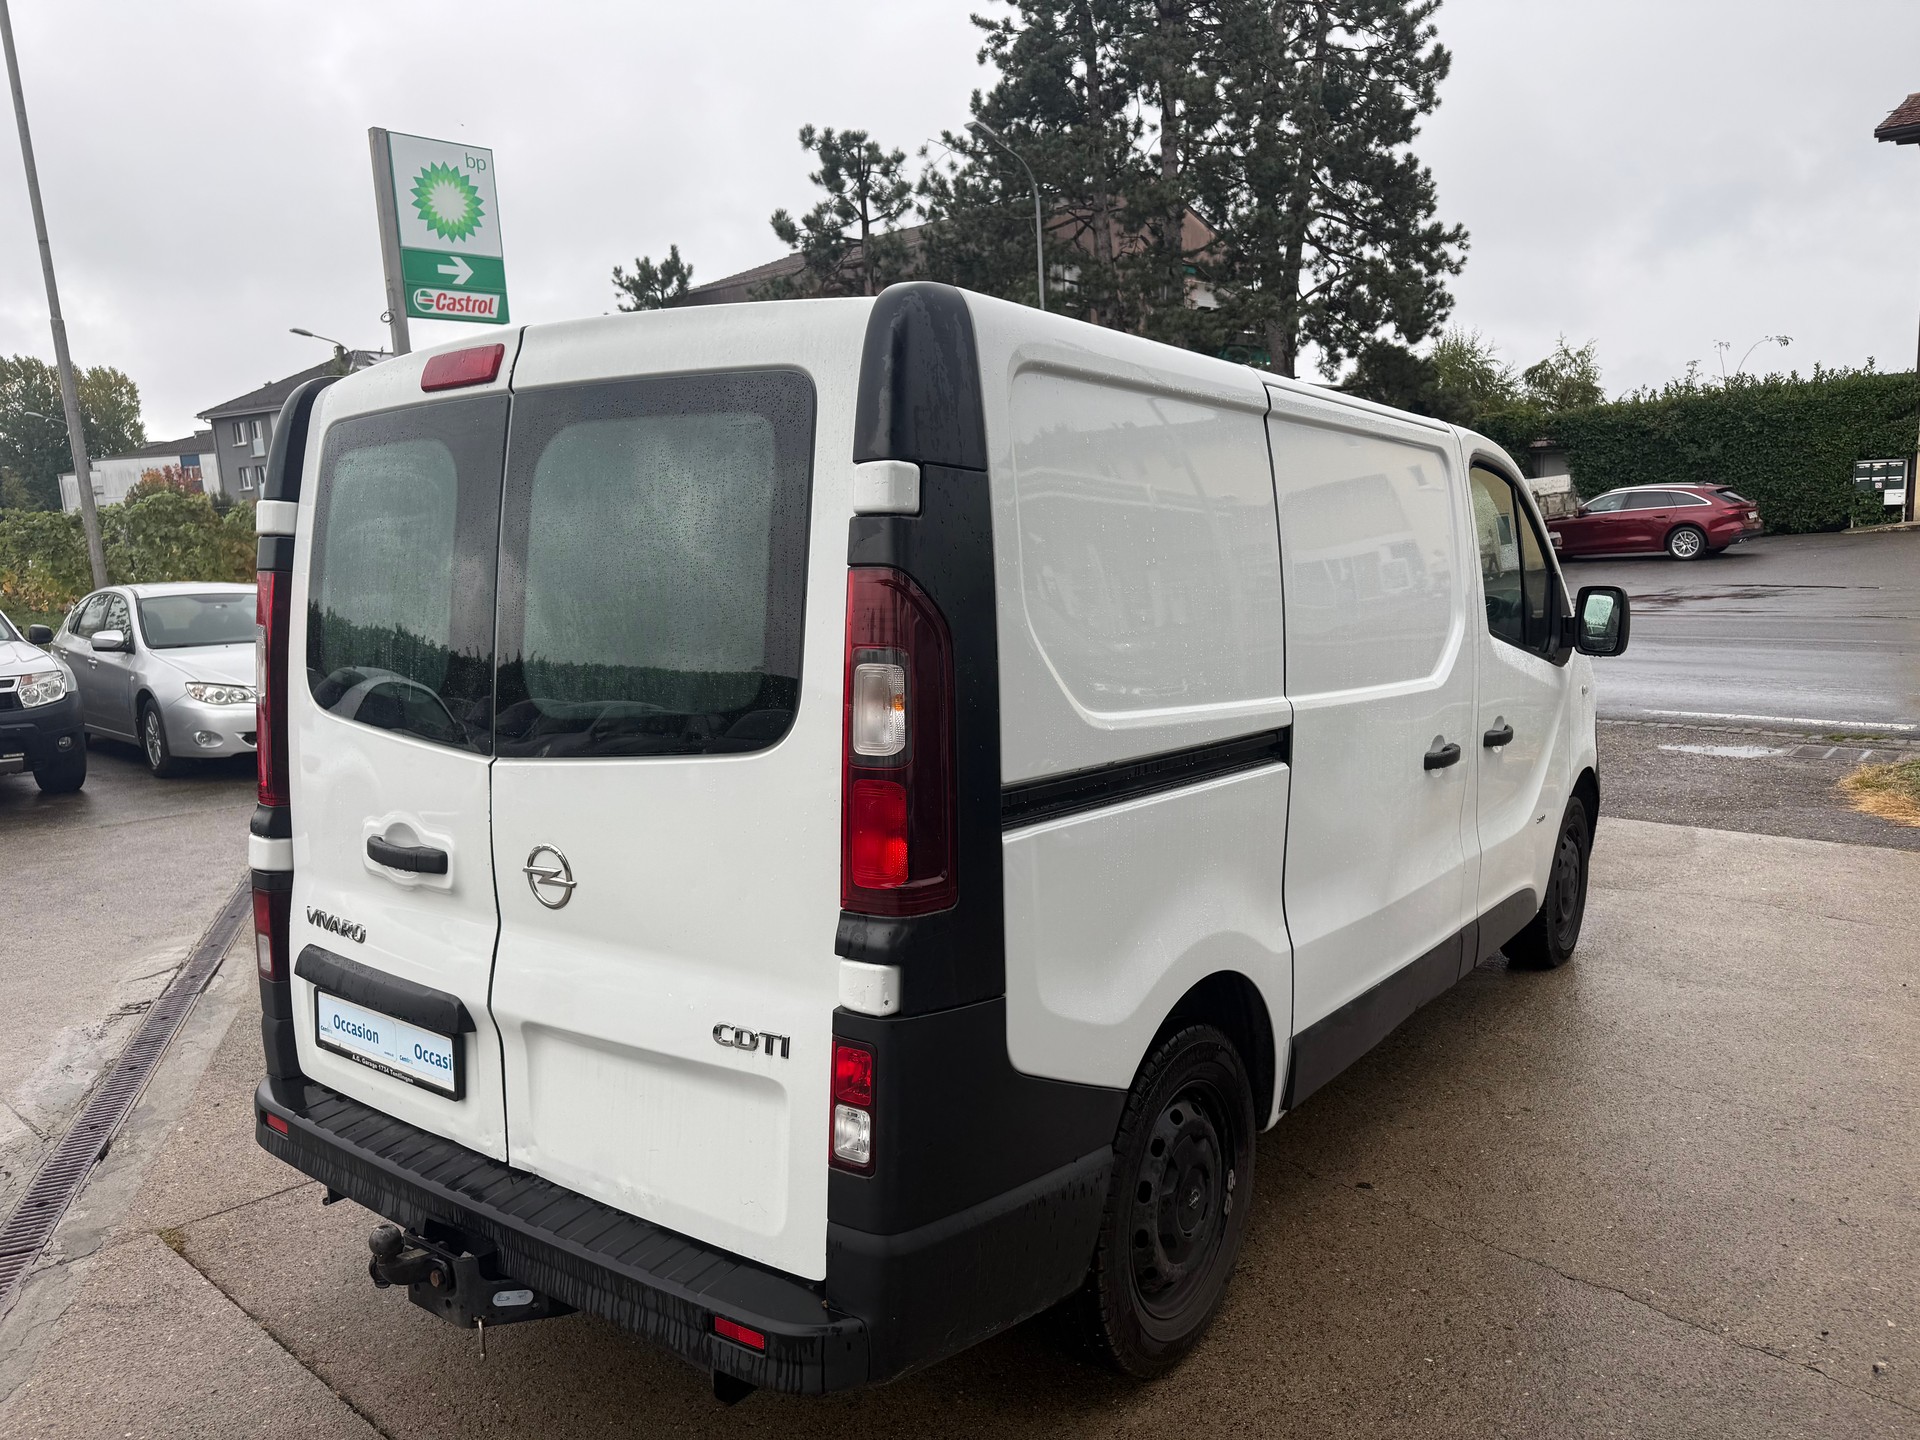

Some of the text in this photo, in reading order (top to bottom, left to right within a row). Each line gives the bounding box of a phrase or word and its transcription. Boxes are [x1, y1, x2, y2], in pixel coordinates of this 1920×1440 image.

[465, 152, 487, 174] bp
[435, 292, 495, 315] Castrol
[306, 905, 367, 944] VIVARO
[333, 1014, 380, 1044] Occasion
[712, 1021, 791, 1060] CDTI
[362, 1057, 378, 1069] Garage
[414, 1043, 452, 1071] Occasi
